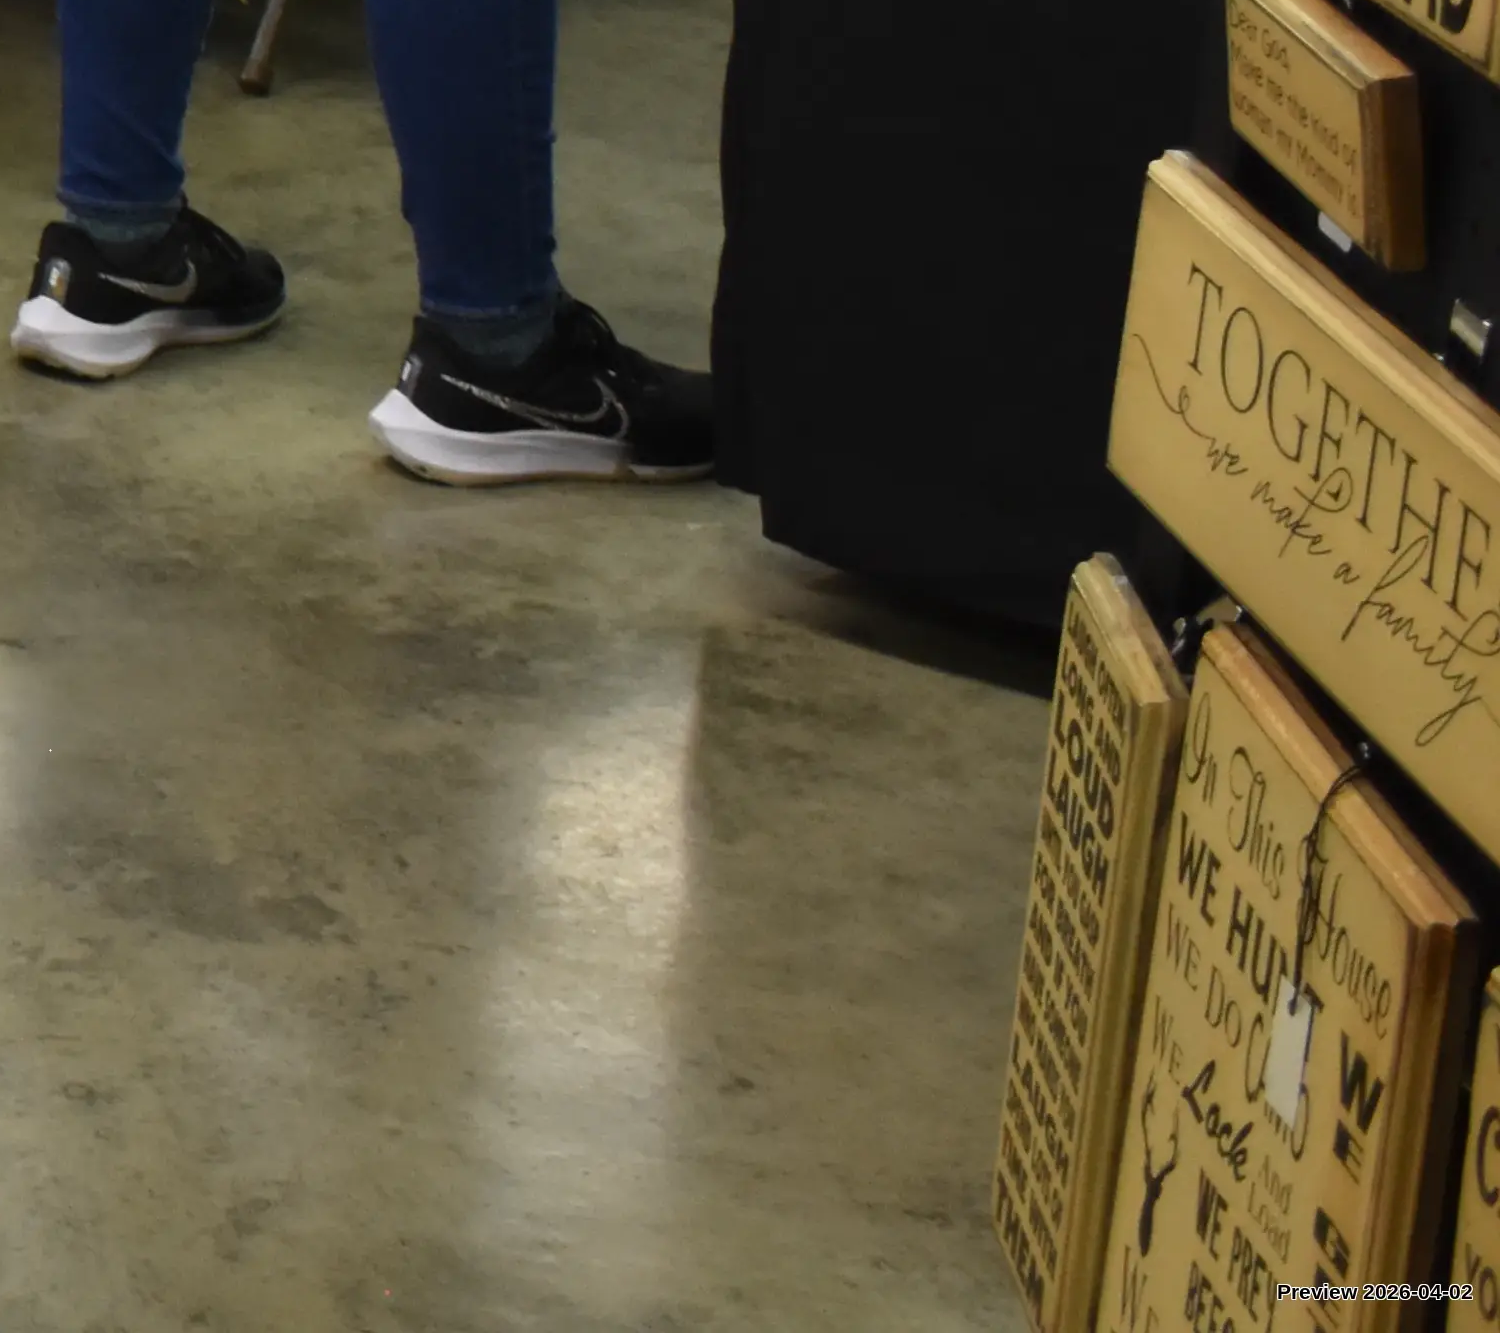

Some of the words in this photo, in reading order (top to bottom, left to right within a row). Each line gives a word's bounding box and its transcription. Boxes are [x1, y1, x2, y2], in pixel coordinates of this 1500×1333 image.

[1187, 261, 1500, 624] TOGETHE
[1206, 435, 1248, 476] we
[1251, 467, 1354, 559] make
[1332, 560, 1361, 587] a
[1341, 534, 1491, 745] family
[1046, 745, 1109, 908] LAUGH
[1054, 688, 1115, 841] LOUD
[1178, 810, 1221, 928] WE
[1183, 691, 1218, 809] In
[1227, 746, 1285, 901] This
[1297, 833, 1392, 1040] House
[1166, 902, 1201, 992] WE
[1204, 964, 1243, 1049] DO
[996, 1168, 1044, 1326] THEM
